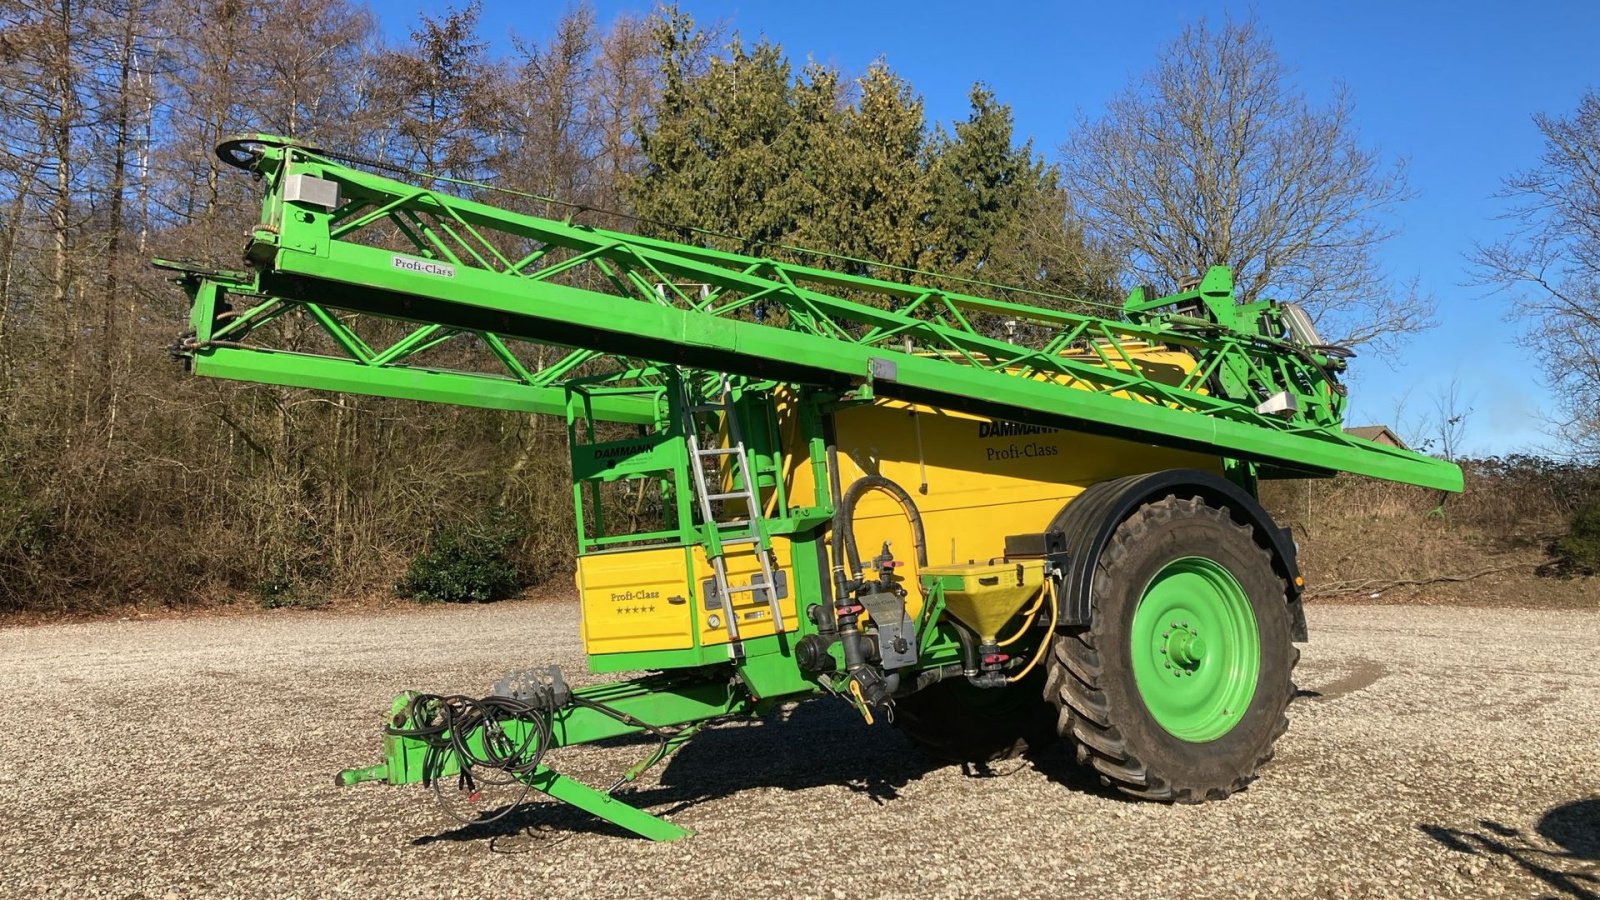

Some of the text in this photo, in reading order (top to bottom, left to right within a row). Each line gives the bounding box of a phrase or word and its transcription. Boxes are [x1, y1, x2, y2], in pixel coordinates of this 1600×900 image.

[394, 258, 454, 277] Profi-Class
[594, 443, 654, 459] DAMMANN
[986, 442, 1058, 461] Profi-Class
[611, 590, 660, 602] Profi-Class
